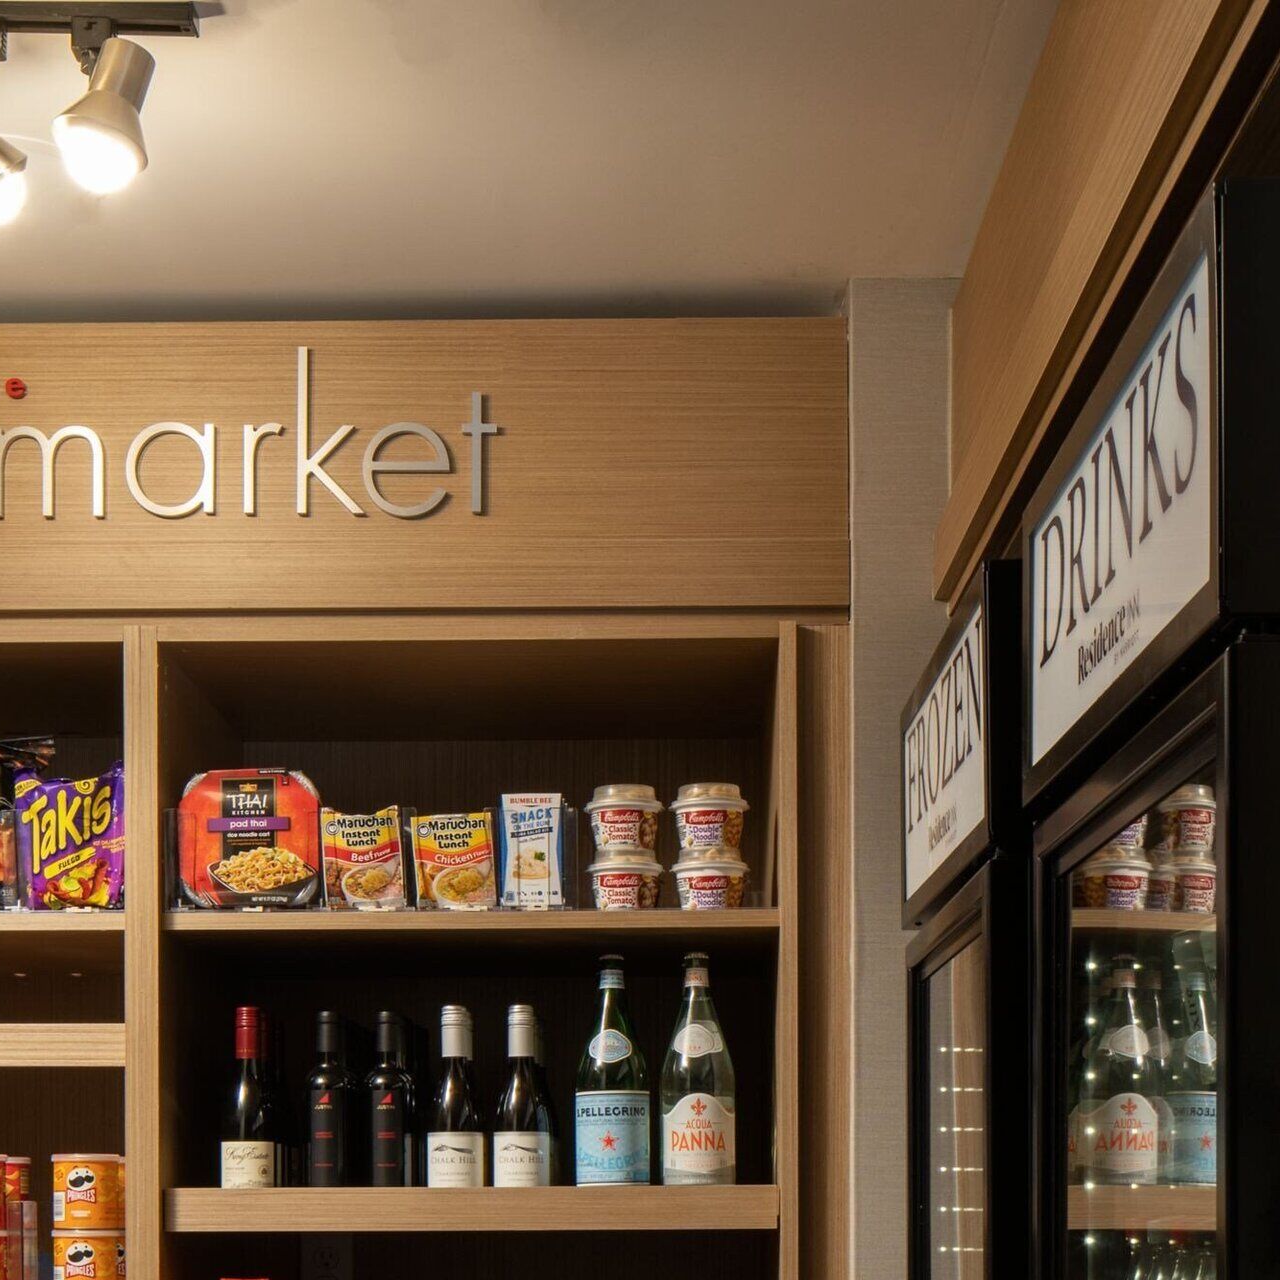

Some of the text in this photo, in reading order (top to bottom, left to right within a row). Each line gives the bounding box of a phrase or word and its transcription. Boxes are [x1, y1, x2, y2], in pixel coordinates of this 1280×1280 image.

[1039, 293, 1199, 668] DRINKS
[1078, 605, 1126, 685] Residence
[908, 614, 983, 835] FROZEN
[225, 794, 268, 812] THAI
[509, 797, 536, 805] BUMBLE
[510, 807, 553, 824] SNACK
[230, 818, 268, 830] pad thai
[337, 816, 394, 829] Maruchan
[428, 818, 486, 831] Maruchan
[341, 829, 381, 839] Instant
[609, 825, 634, 833] Classic
[693, 825, 720, 834] Double
[433, 831, 473, 841] Instant
[607, 833, 635, 841] Tomato
[694, 833, 720, 841] Noodle
[346, 837, 378, 847] Lunch
[438, 839, 470, 849] Lunch
[350, 850, 374, 862] Beef
[434, 852, 473, 864] Chicken
[608, 889, 632, 897] Classic
[697, 891, 722, 899] Double
[607, 897, 633, 905] Tomato
[685, 1119, 713, 1130] ACQUA
[671, 1130, 726, 1152] PANNA
[66, 1189, 96, 1204] PRINGLES
[65, 1265, 96, 1279] PRINGLES
